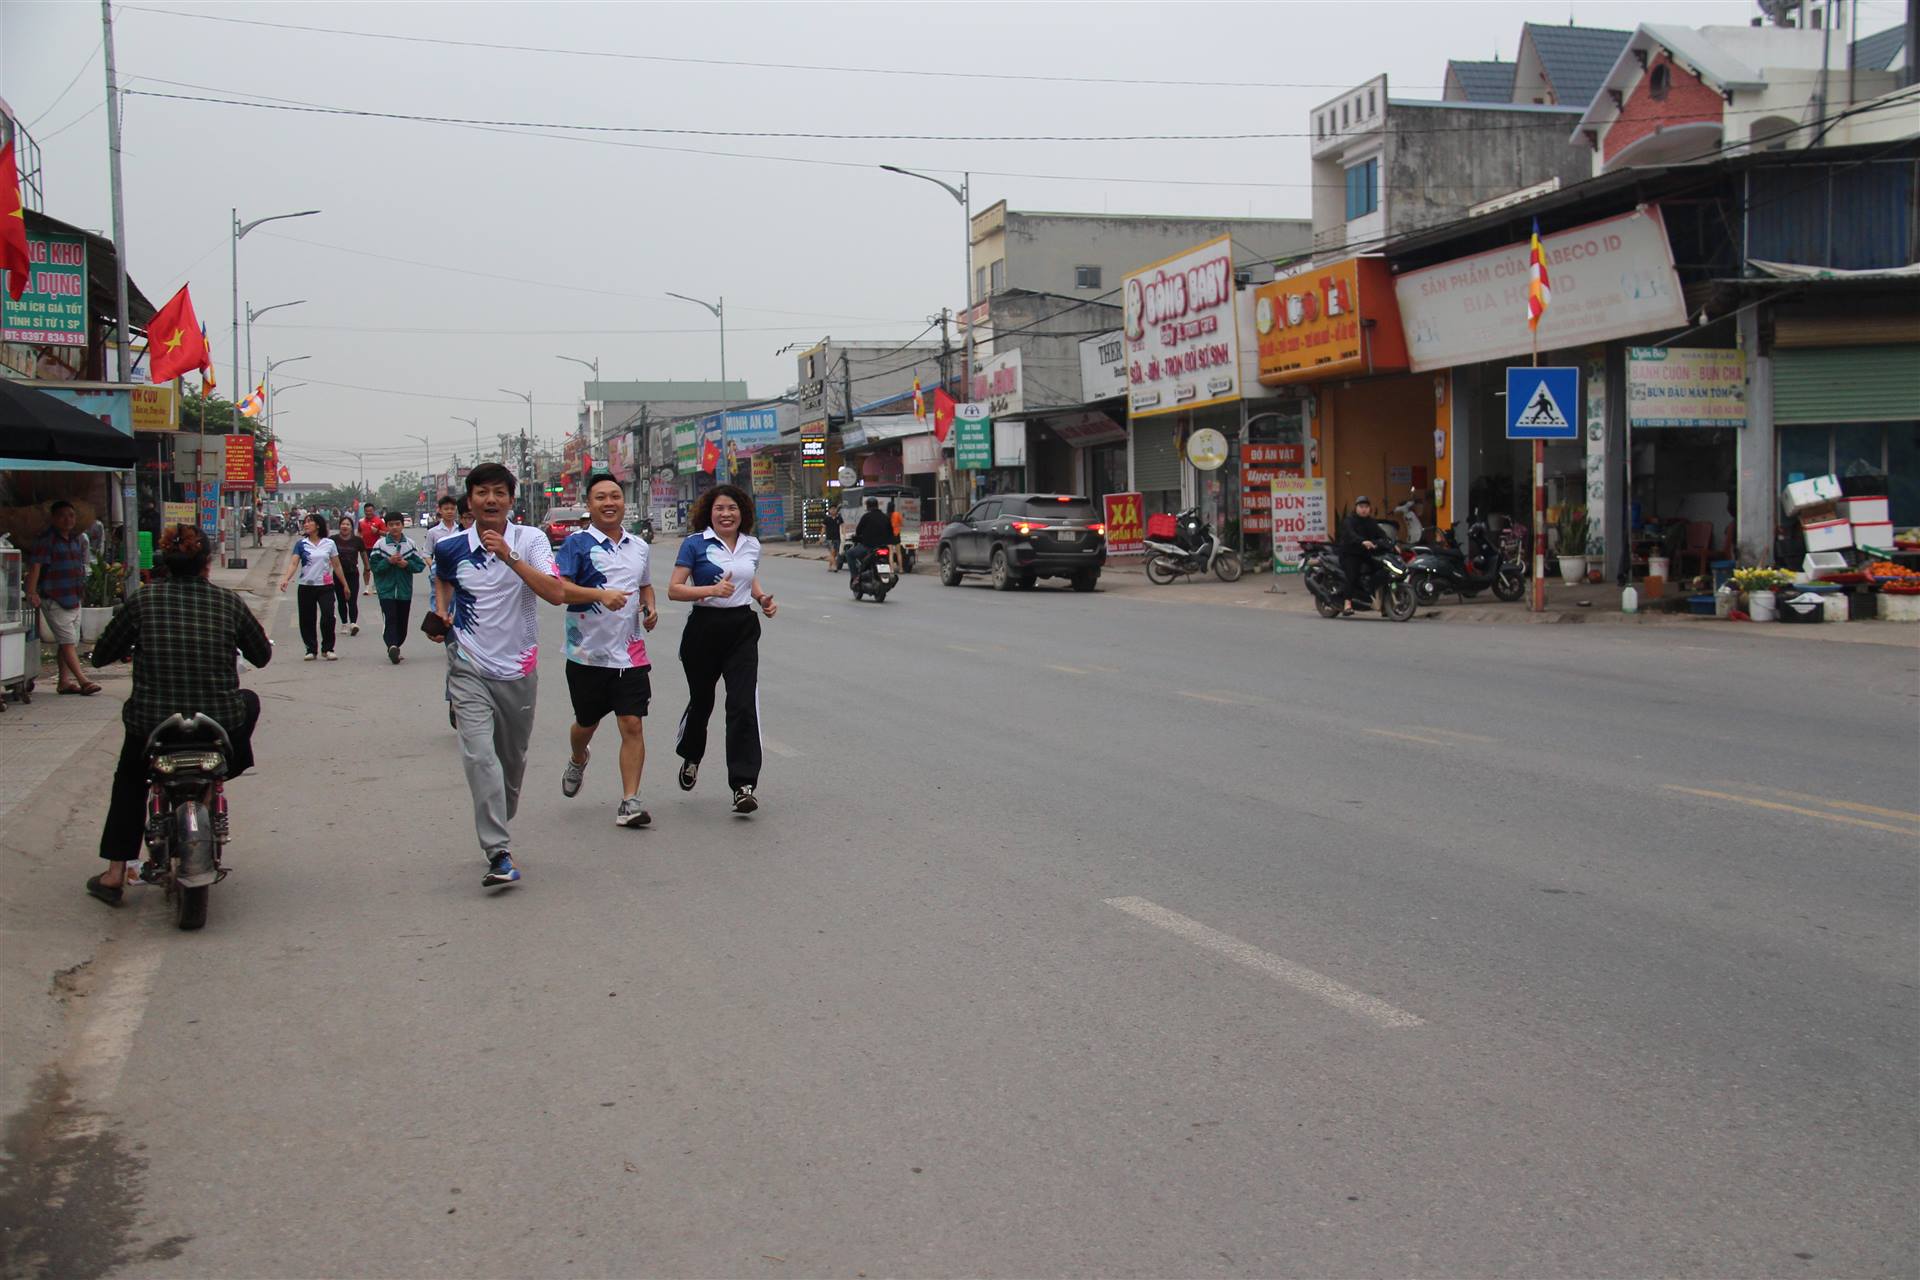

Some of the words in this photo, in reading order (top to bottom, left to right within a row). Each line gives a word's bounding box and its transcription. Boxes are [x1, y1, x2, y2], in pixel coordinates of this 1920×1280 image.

[50, 242, 84, 267] KHO
[37, 271, 82, 300] DỤNG
[1188, 256, 1230, 312] BABY
[1421, 276, 1447, 297] SẢN
[1450, 262, 1491, 293] PHẨM
[1494, 255, 1527, 281] CỦA
[67, 320, 81, 329] SP
[726, 415, 748, 431] MINH
[749, 414, 762, 430] AN
[1111, 496, 1137, 525] XẢ
[1275, 493, 1305, 510] BÚN
[1275, 512, 1306, 532] PHỞ
